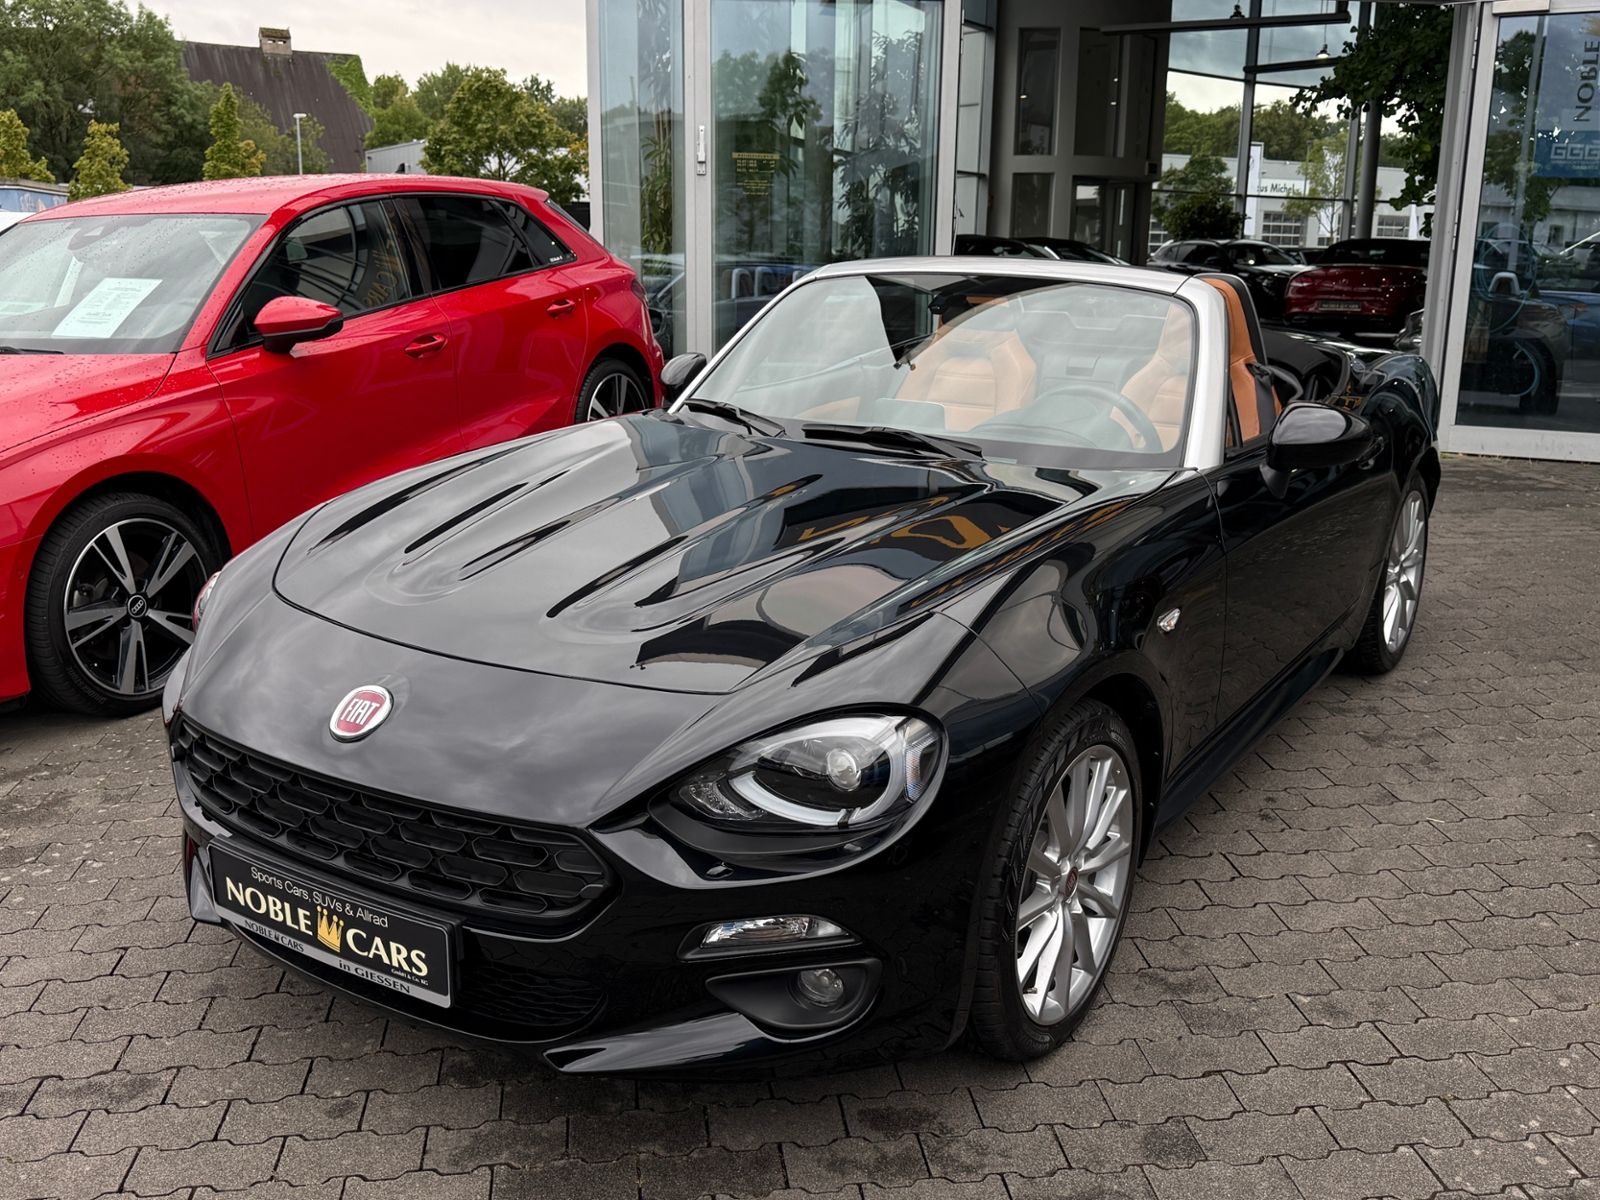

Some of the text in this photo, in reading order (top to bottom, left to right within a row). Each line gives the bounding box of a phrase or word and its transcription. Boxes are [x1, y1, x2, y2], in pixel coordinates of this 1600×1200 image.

[1573, 41, 1600, 122] NOBLE
[340, 698, 381, 726] FIAT
[250, 866, 388, 928] Sports Cars, SUVs & Allrad
[226, 876, 428, 976] NOBLE CARS
[244, 919, 304, 952] NOBLE CARS
[339, 959, 410, 993] in GIESSEN
